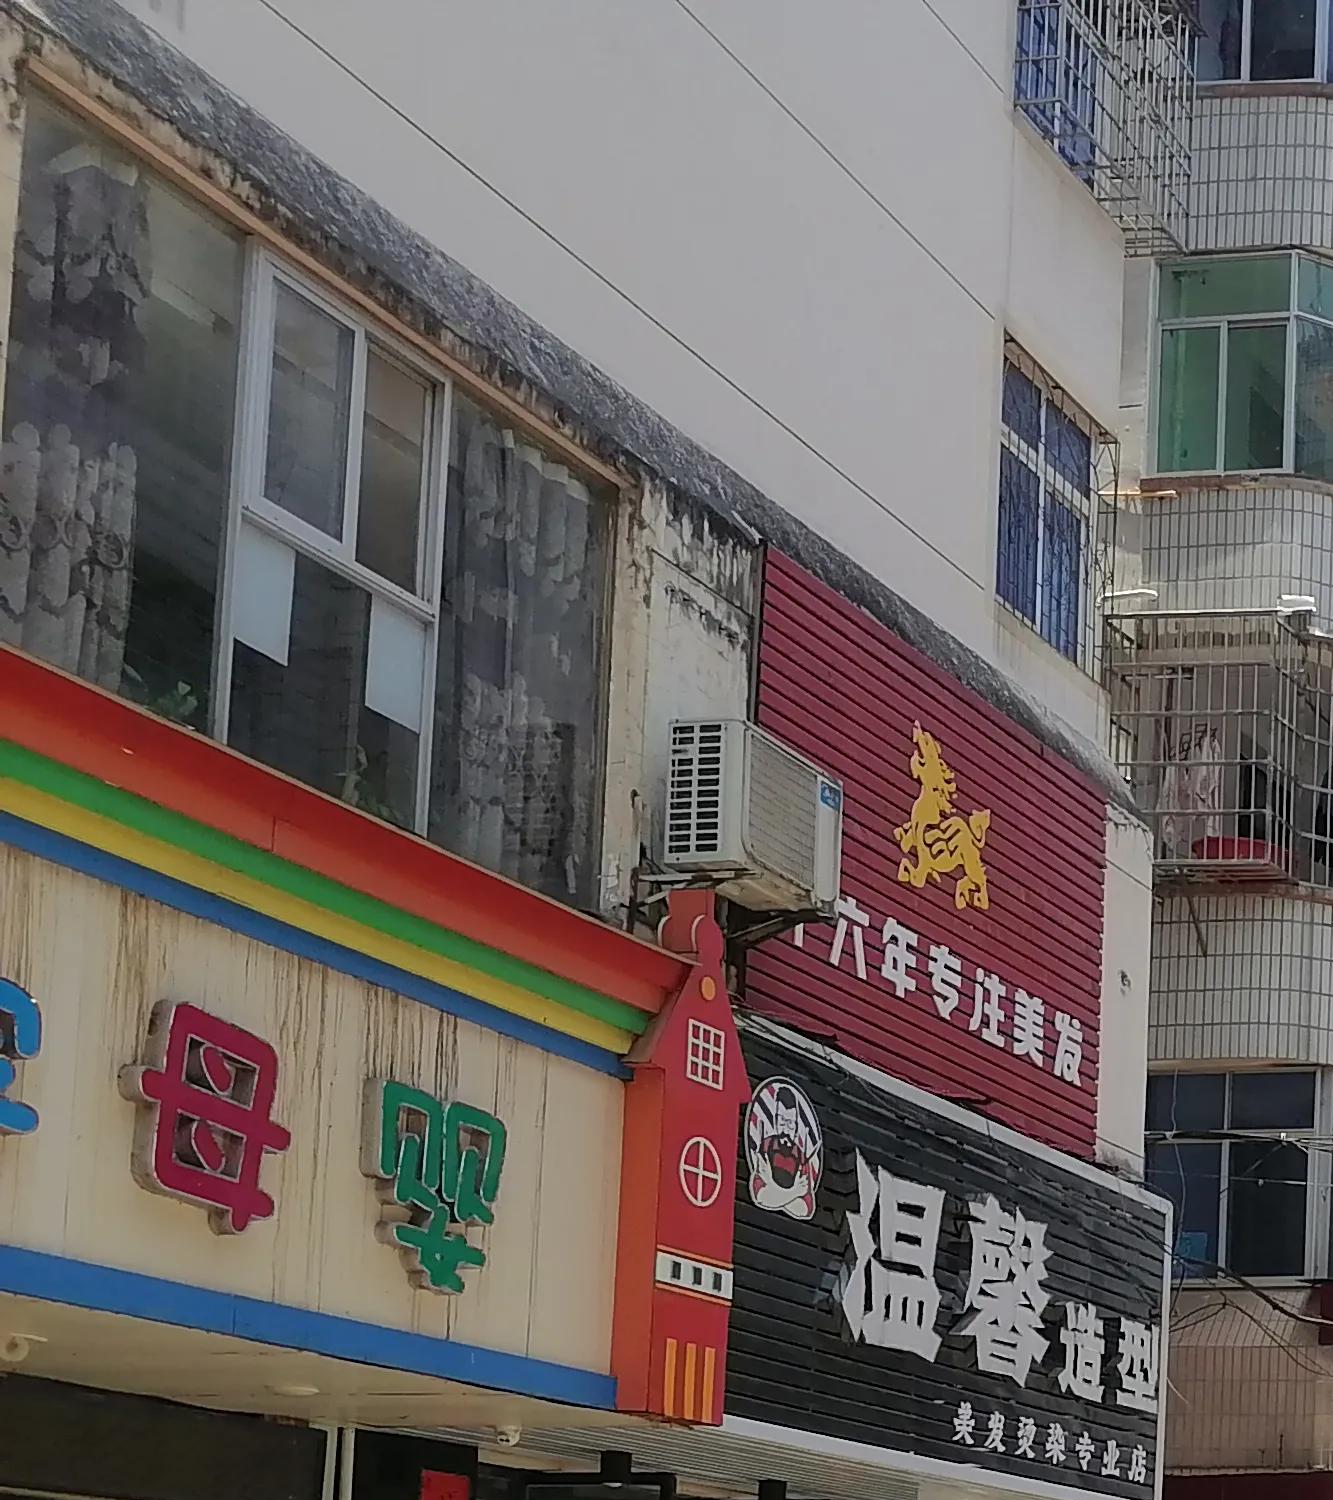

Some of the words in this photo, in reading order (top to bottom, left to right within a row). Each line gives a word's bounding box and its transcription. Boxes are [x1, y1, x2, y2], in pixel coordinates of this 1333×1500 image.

[794, 896, 1083, 1087] 六年专注美发
[842, 1148, 1159, 1414] 温馨造型
[951, 1401, 1147, 1485] 美发烫染专业店
